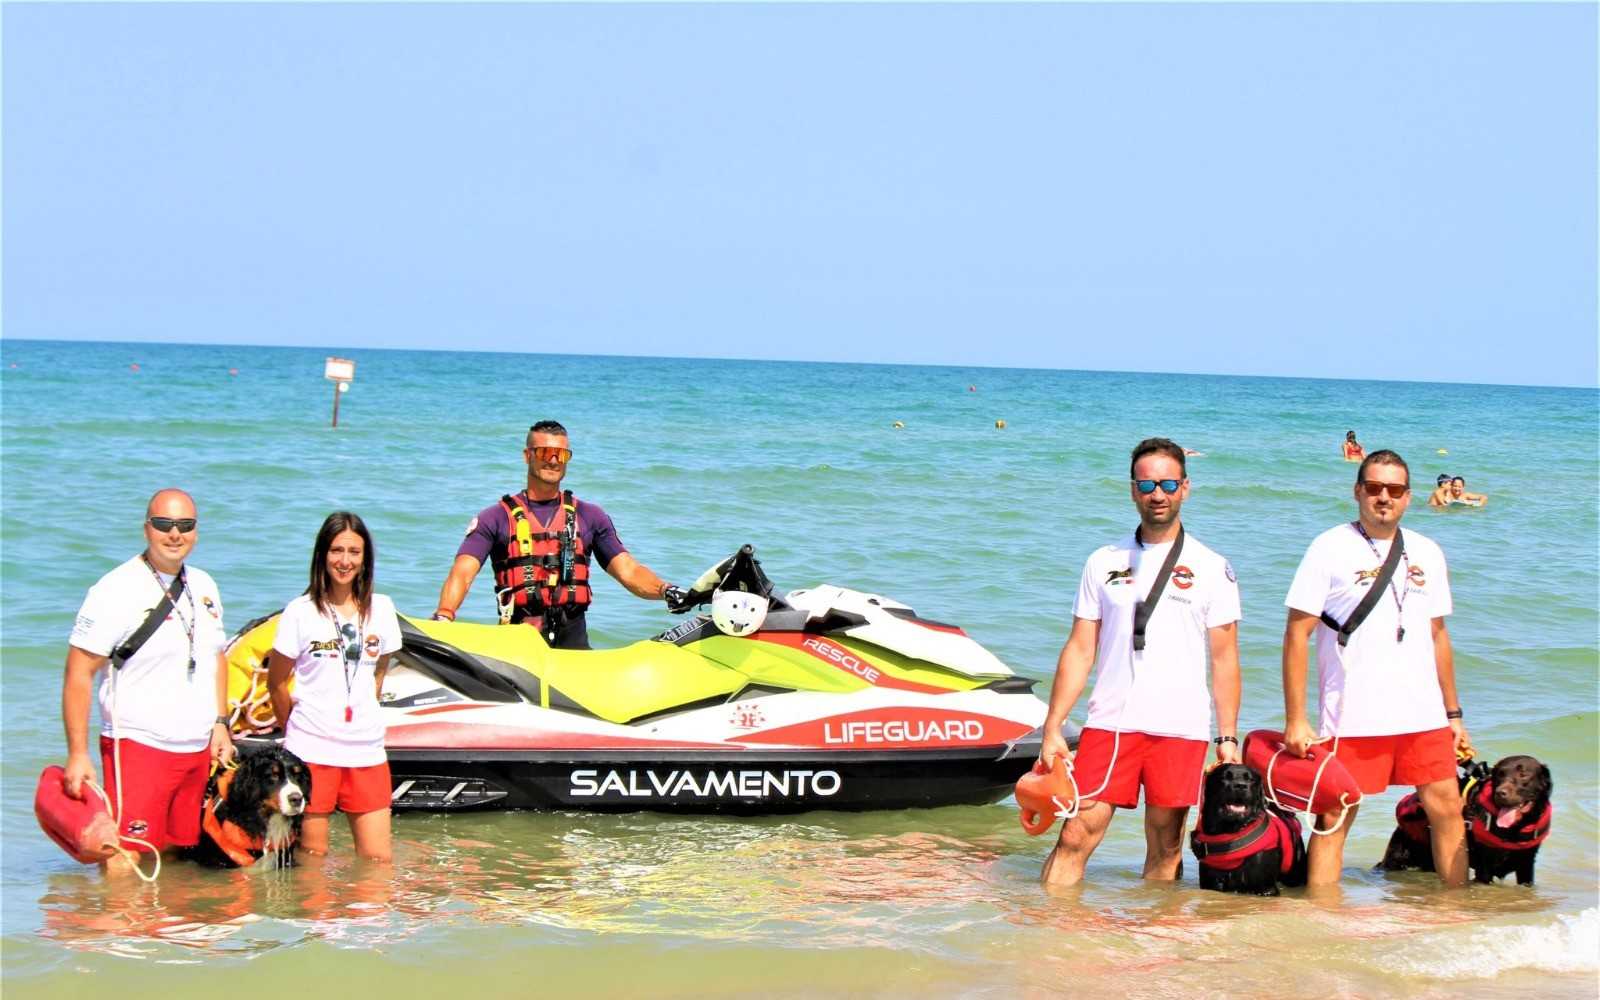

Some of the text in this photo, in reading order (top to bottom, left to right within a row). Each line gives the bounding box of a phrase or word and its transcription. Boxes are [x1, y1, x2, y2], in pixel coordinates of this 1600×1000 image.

[803, 639, 880, 683] RESCUE
[824, 720, 984, 744] LIFEGUARD
[570, 770, 841, 796] SALVAMENTO
